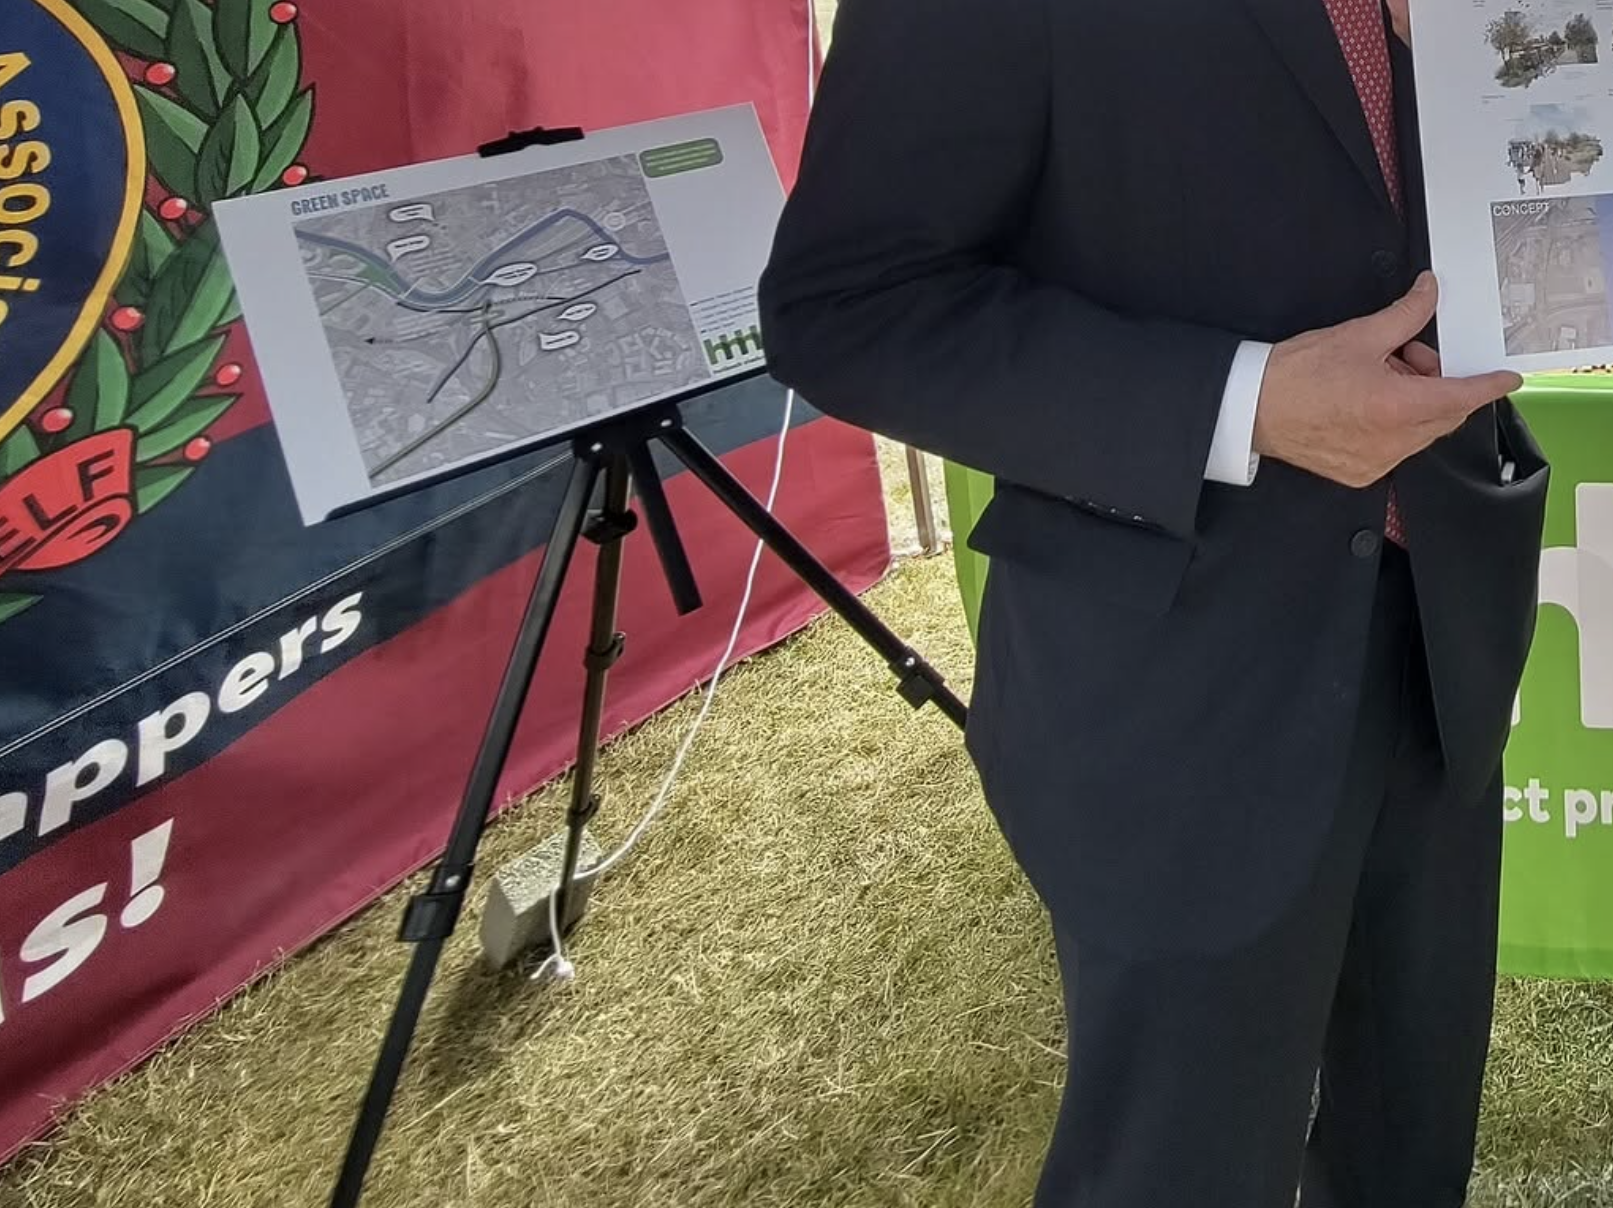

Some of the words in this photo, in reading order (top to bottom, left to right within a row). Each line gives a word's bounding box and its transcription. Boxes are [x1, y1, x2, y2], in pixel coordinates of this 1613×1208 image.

[291, 193, 340, 216] GREEN
[341, 183, 390, 206] SPACE
[1493, 202, 1550, 217] CONCEPT
